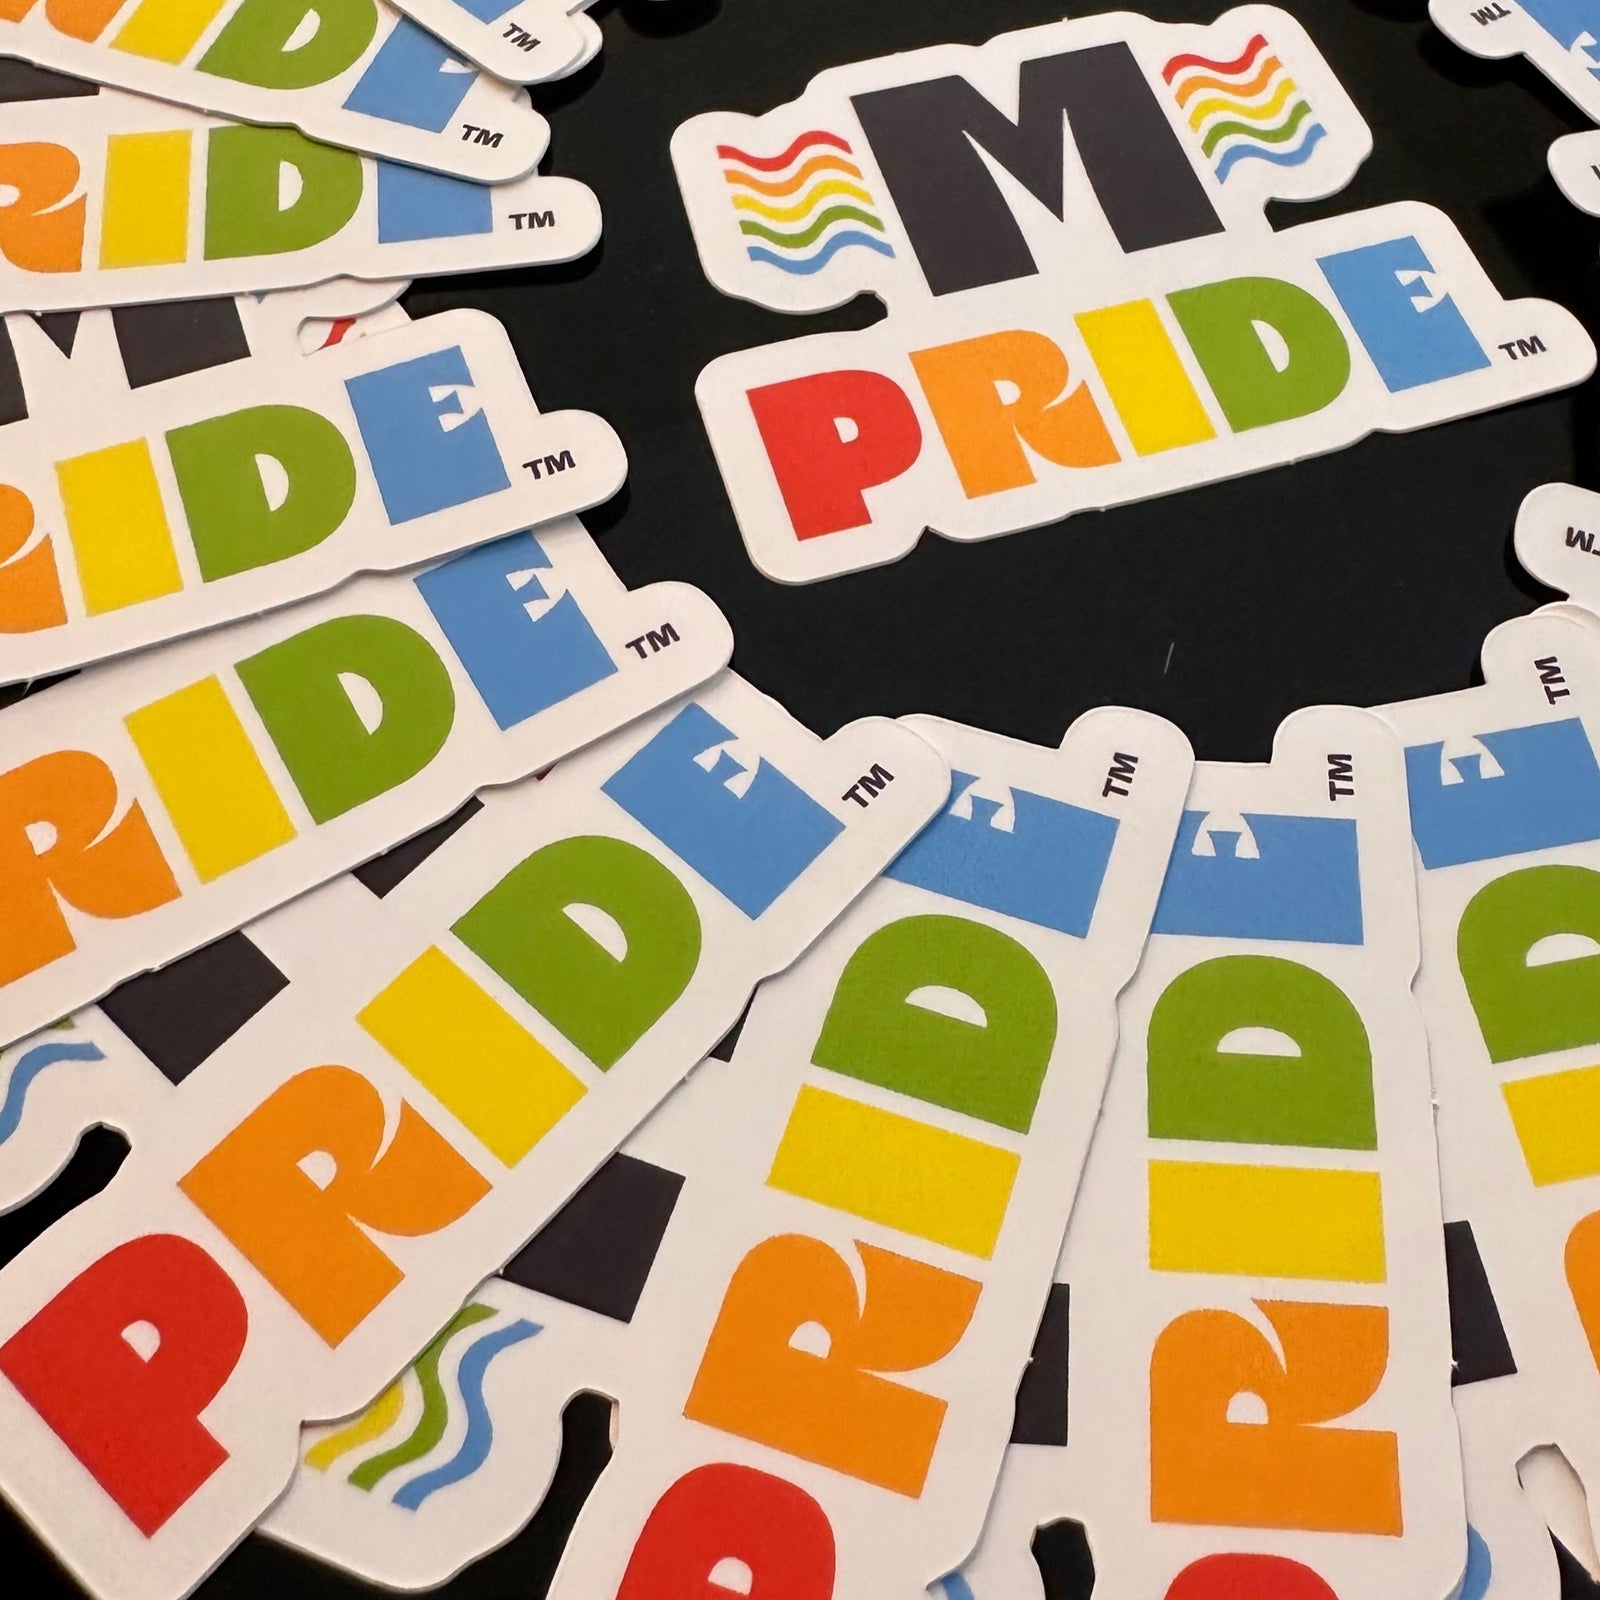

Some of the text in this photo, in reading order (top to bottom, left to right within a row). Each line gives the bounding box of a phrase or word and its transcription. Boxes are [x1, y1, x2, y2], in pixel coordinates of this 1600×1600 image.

[1470, 2, 1512, 26] TM
[502, 22, 541, 52] TM
[461, 124, 504, 148] TM
[849, 42, 1224, 297] M
[508, 210, 555, 231] TM
[746, 235, 1547, 541] PRIDE TM
[522, 450, 576, 480] TM
[1565, 526, 1600, 557] M
[624, 622, 681, 659] TM
[1533, 656, 1571, 705] TM
[1102, 752, 1139, 798] TM
[0, 703, 846, 1538] PRIDE
[841, 763, 895, 808] TM
[1147, 753, 1404, 1600] RIDE TM
